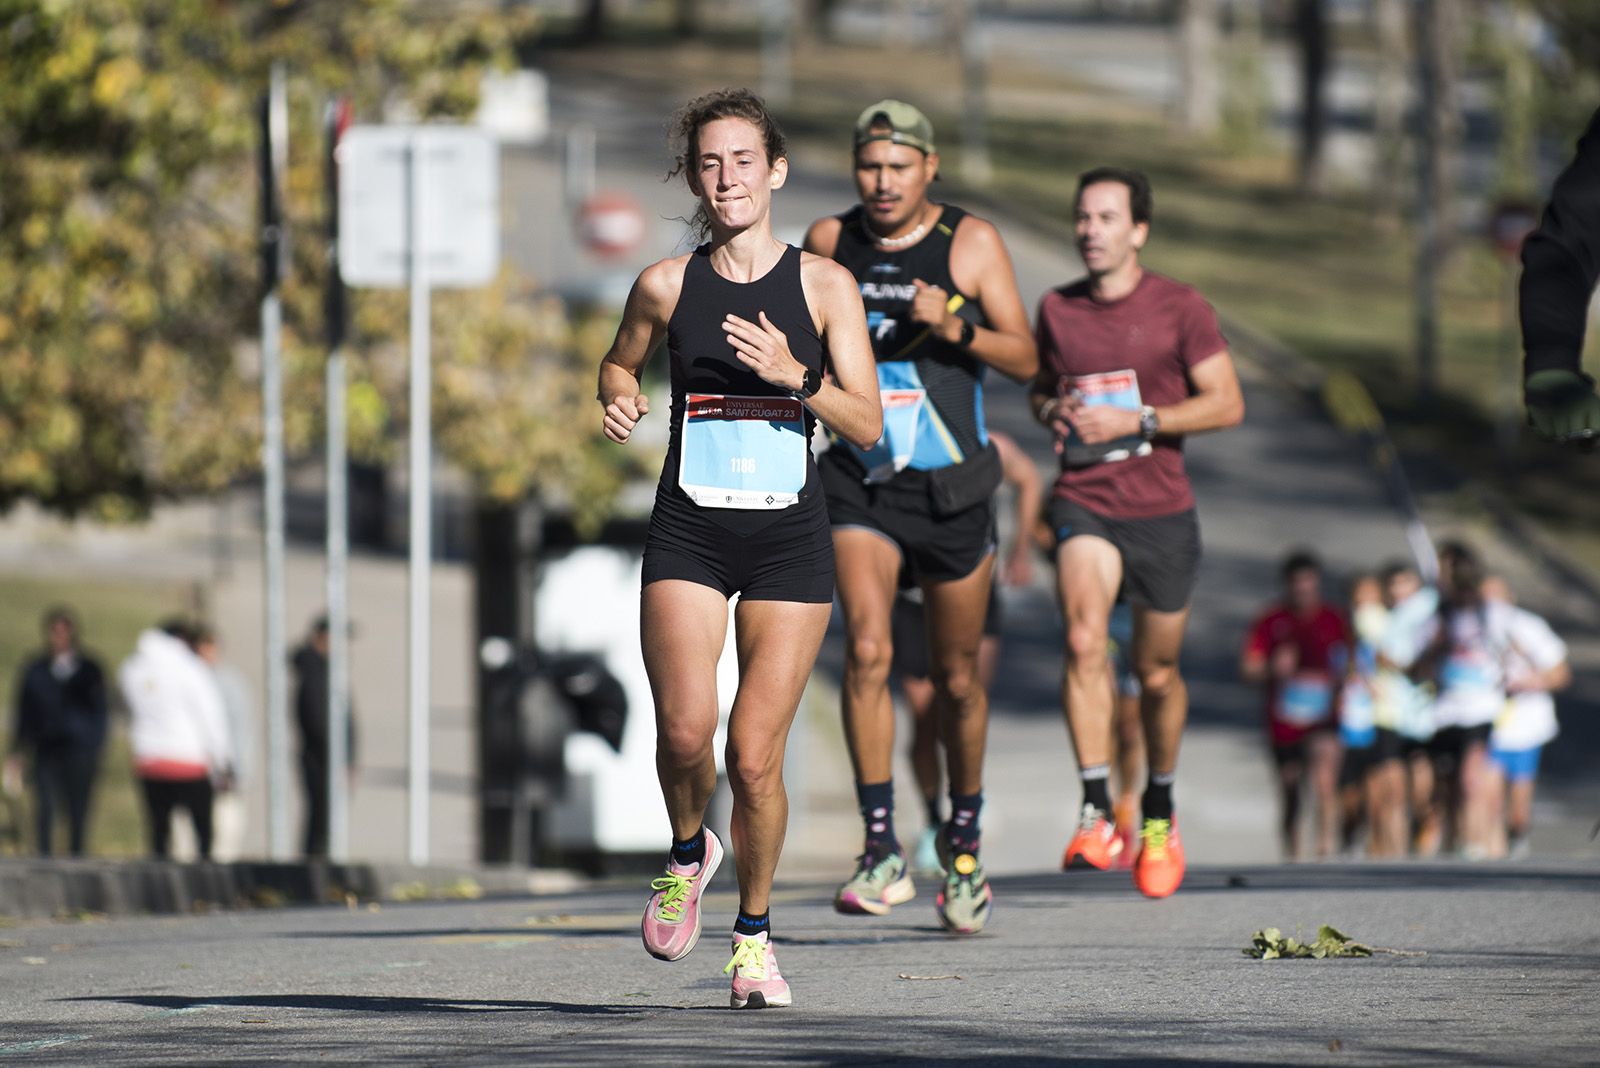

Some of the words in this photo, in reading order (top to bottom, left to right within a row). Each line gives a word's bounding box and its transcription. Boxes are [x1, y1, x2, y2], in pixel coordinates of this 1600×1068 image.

[725, 407, 750, 417] SANT
[750, 408, 784, 418] CUGAT
[783, 409, 796, 419] 23
[730, 457, 756, 474] 1186
